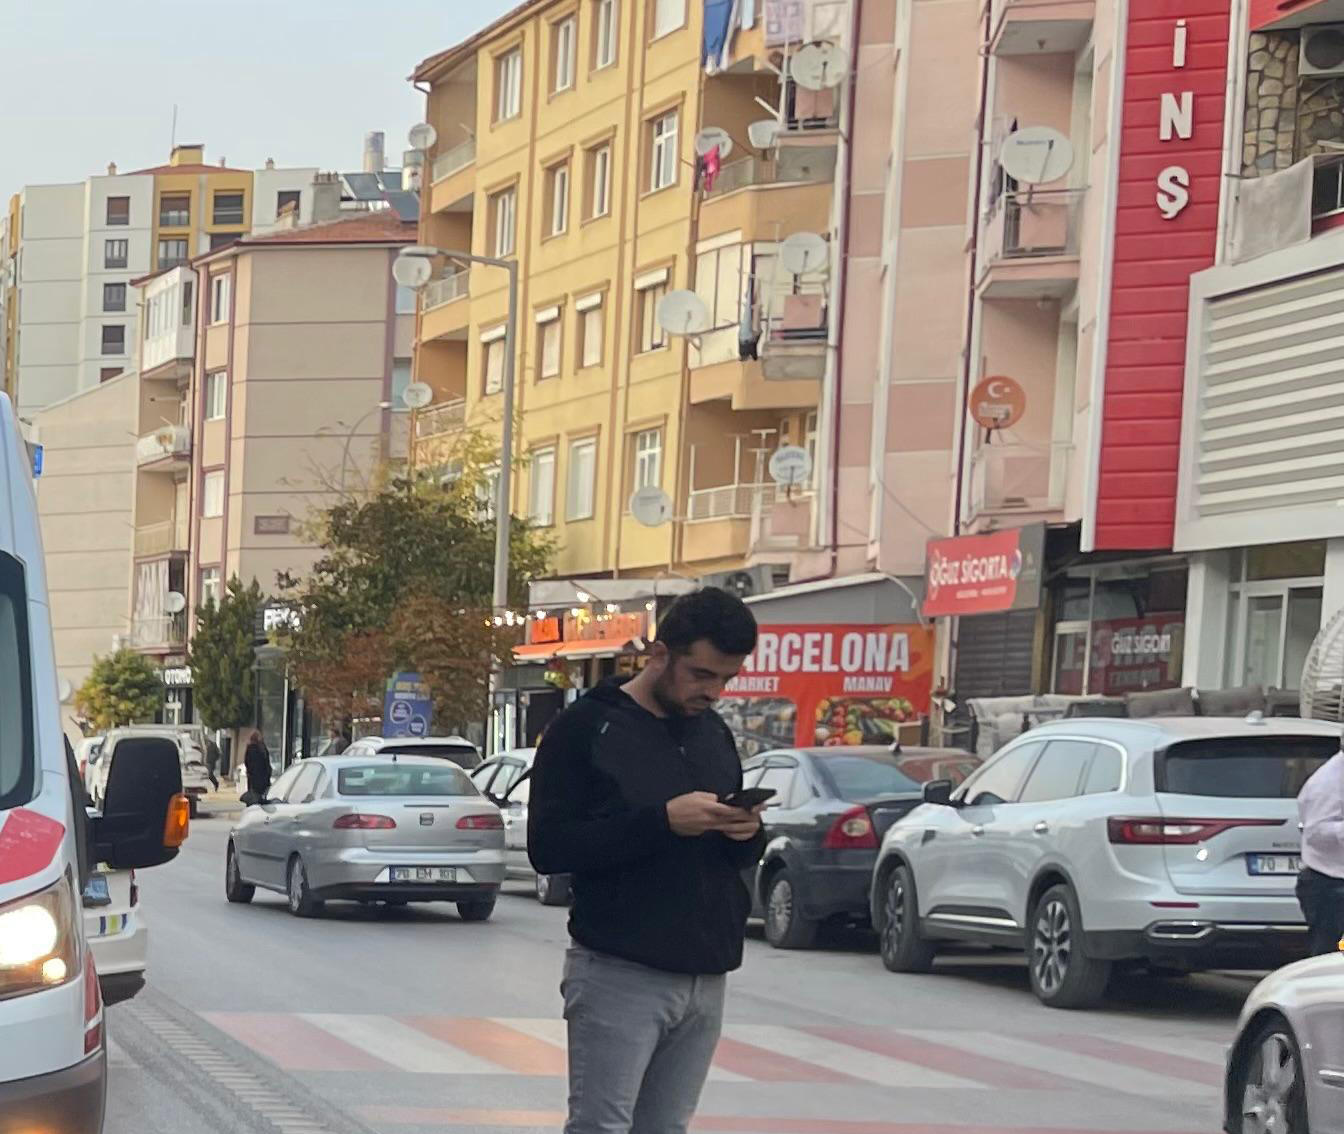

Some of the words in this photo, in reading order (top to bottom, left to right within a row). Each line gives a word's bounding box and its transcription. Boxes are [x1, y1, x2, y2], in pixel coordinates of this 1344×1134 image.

[164, 667, 194, 685] OTOMO
[725, 676, 780, 692] MARKET
[843, 677, 893, 692] MANAV
